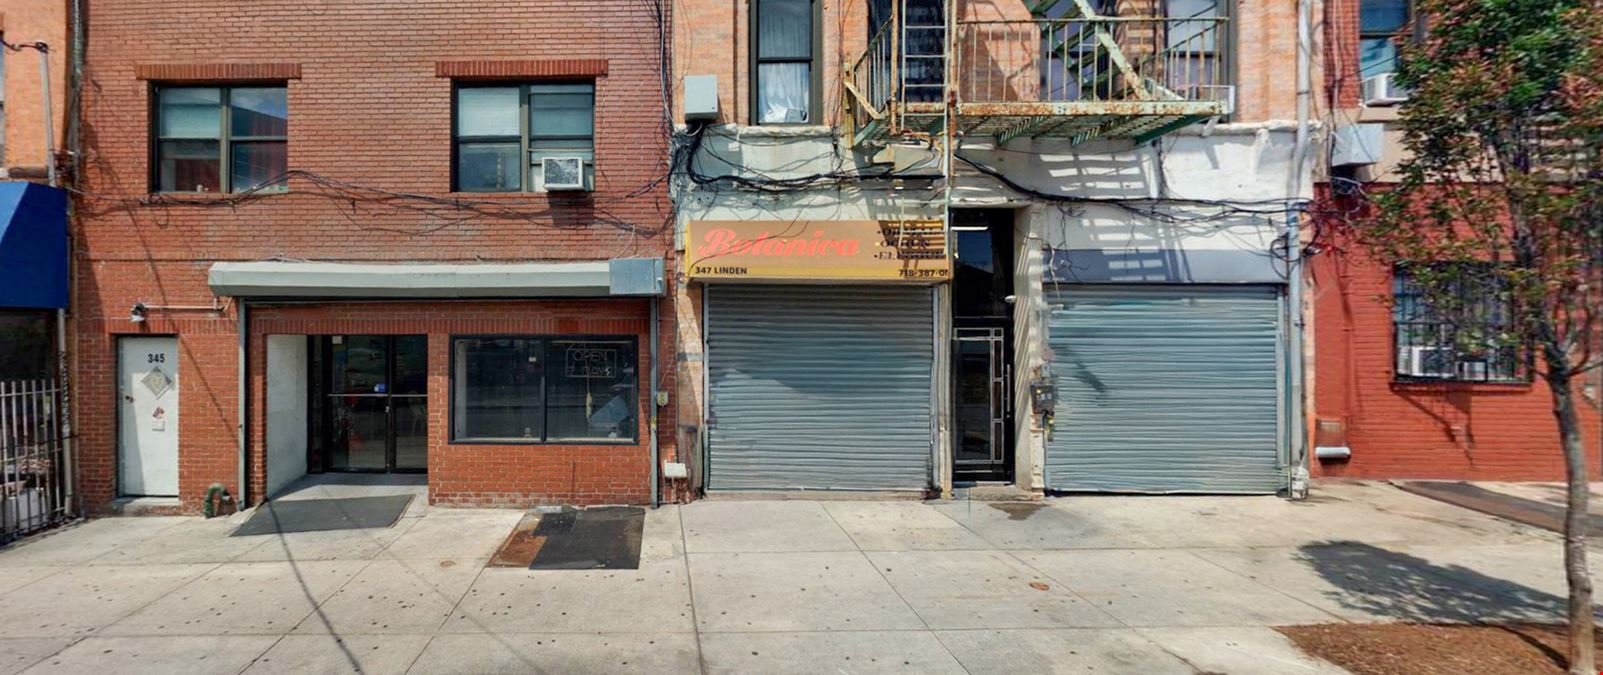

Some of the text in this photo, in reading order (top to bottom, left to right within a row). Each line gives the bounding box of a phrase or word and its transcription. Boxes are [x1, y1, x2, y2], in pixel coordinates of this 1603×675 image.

[698, 227, 859, 257] Botanica
[695, 267, 747, 275] 347 LINDEN
[147, 353, 165, 364] 345
[572, 350, 608, 362] OPEN
